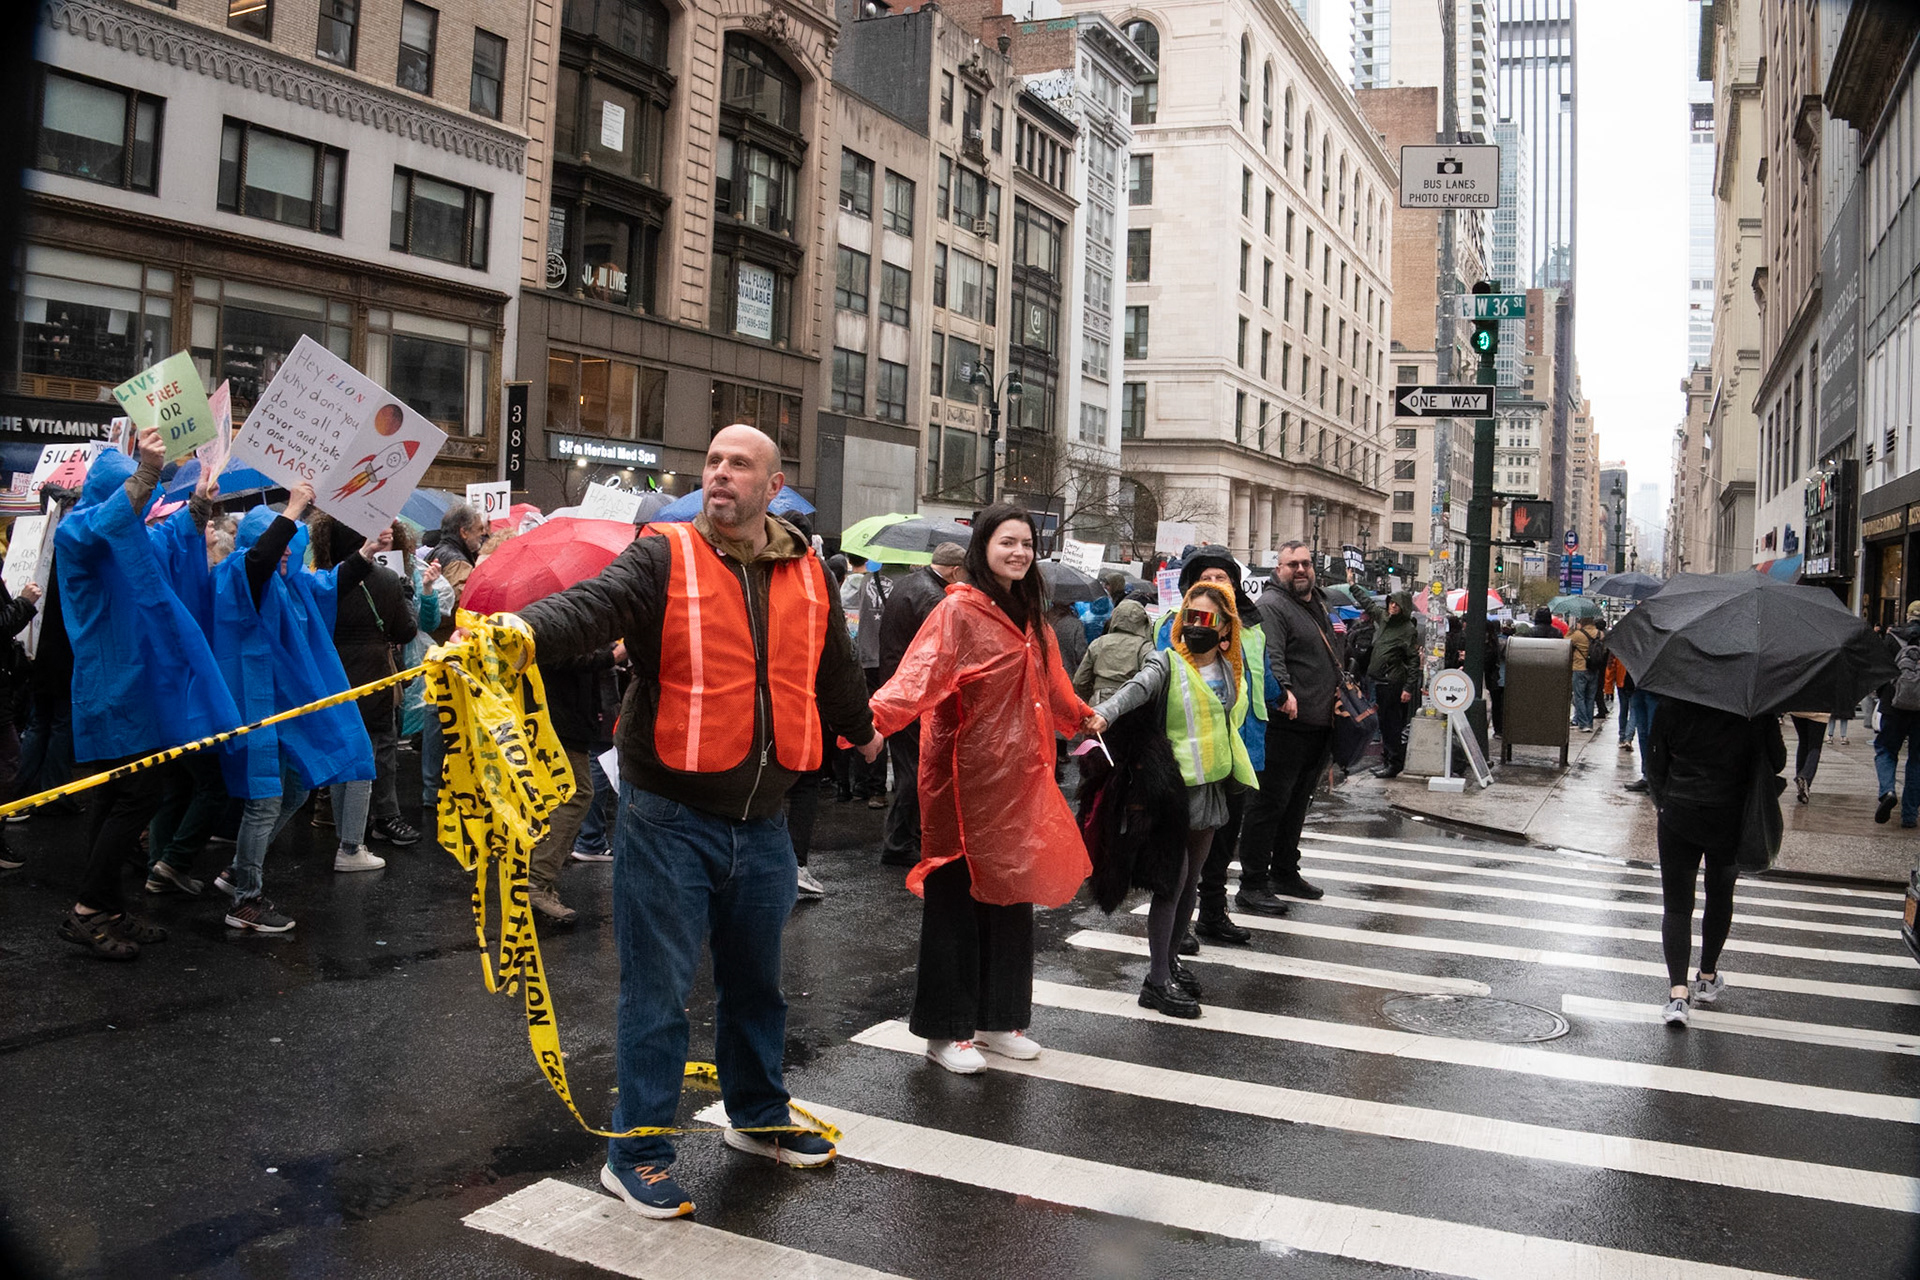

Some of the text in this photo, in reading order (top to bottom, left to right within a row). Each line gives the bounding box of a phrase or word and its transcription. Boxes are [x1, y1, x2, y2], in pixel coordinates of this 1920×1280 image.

[1423, 179, 1476, 190] BUS LANES
[1409, 193, 1490, 203] PHOTO ENFORCED
[1477, 296, 1523, 316] W 36 St
[116, 367, 159, 402] LIVE
[146, 380, 183, 407] FREE
[327, 373, 366, 404] ELON
[160, 402, 183, 421] OR
[1410, 395, 1481, 408] ONE WAY
[271, 389, 341, 440] do us all a
[26, 418, 98, 437] VITAMIN
[170, 416, 197, 440] DIE
[261, 404, 341, 461] favor and take
[247, 433, 260, 448] to
[264, 443, 317, 481] MARS
[253, 421, 331, 473] a one way trip
[583, 442, 617, 459] Herbal
[617, 446, 637, 461] Med
[638, 448, 657, 464] Spa
